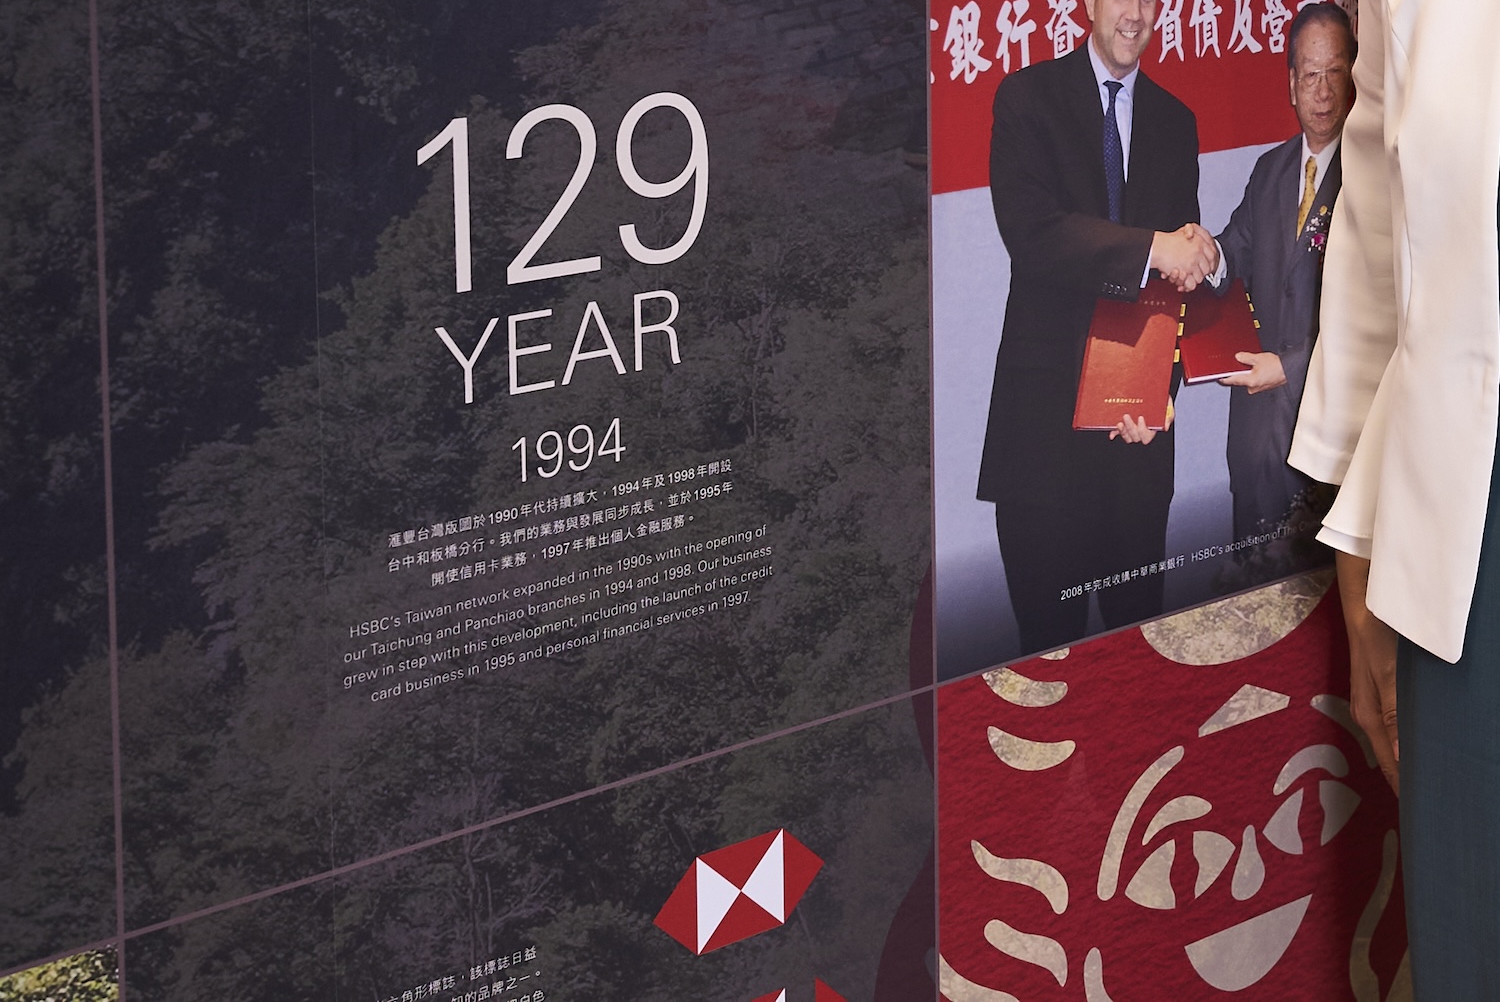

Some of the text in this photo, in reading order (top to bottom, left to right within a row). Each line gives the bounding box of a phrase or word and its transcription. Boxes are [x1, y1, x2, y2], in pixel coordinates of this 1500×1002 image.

[416, 91, 709, 294] 129
[434, 289, 681, 405] YEAR
[511, 417, 627, 483] 1994
[350, 524, 766, 638] HSBC's Taiwan network expanded in the 1990s with the opening of
[1191, 546, 1223, 563] HSBC's
[1225, 533, 1270, 554] acquisition
[1270, 527, 1280, 543] of
[344, 547, 771, 663] our Taichung and Panchiao branches in 1994 and 1998. Our business
[344, 565, 772, 689] grew in step with this development, including the launch of the credit
[371, 591, 751, 701] card business in 1995 and personal financial services in 1997.
